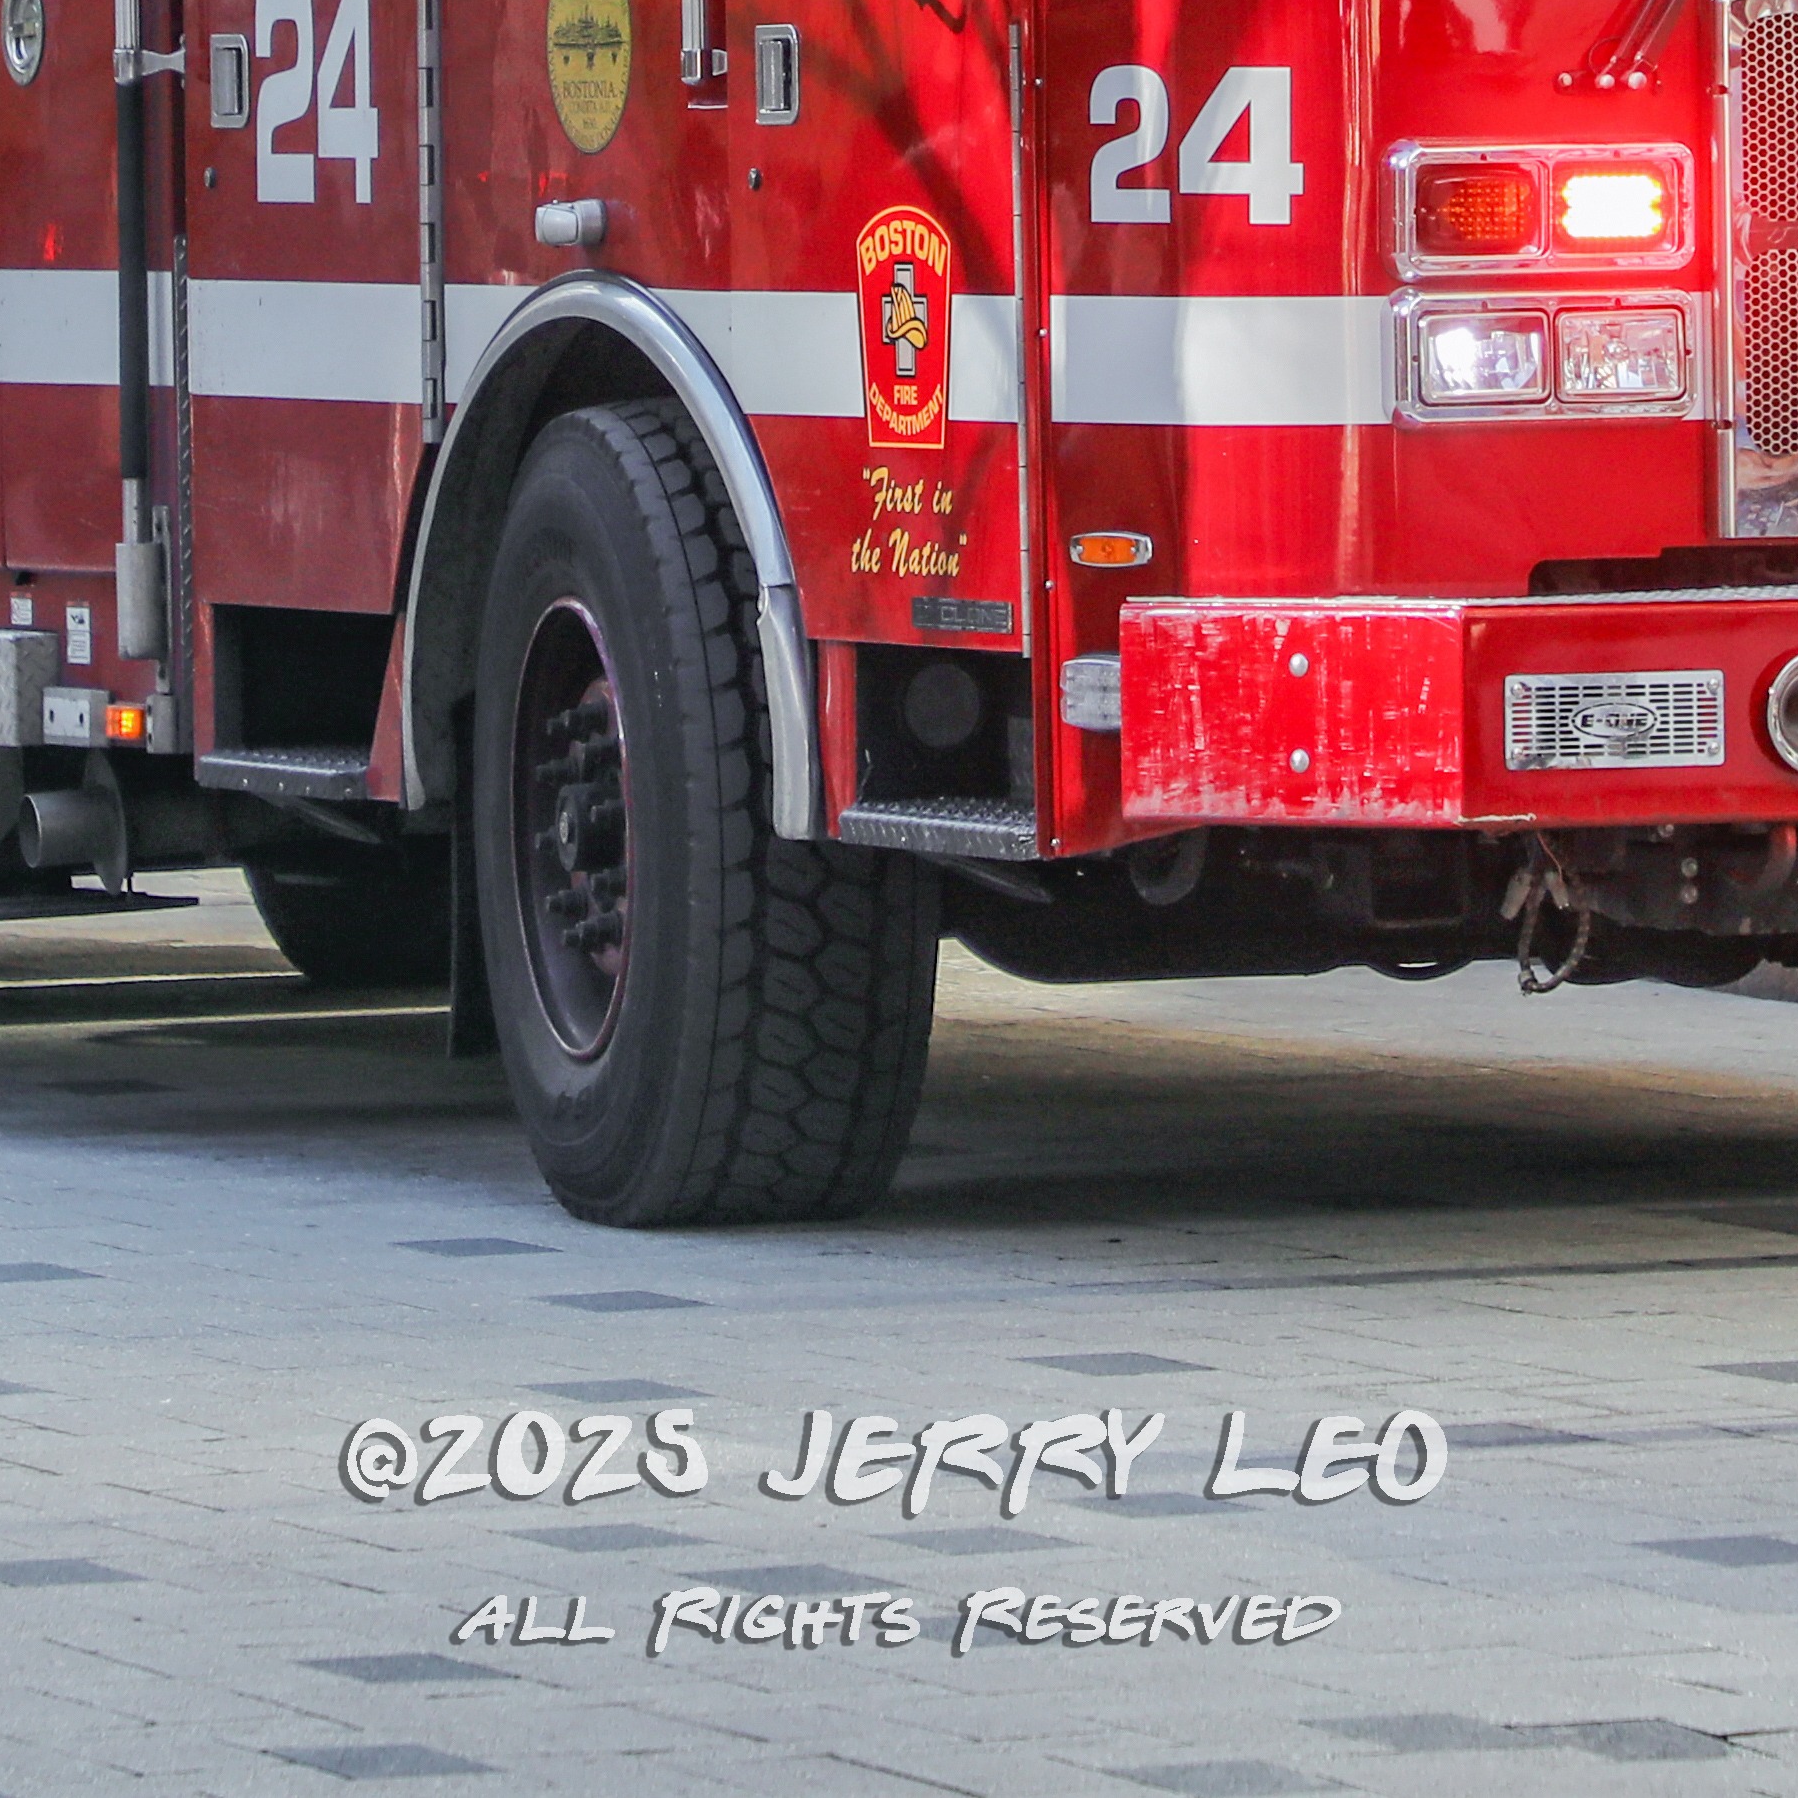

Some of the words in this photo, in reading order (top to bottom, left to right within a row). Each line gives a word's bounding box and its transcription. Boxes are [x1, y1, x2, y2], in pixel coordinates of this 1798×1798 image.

[1089, 65, 1305, 226] 24
[859, 219, 947, 277] BOSTON
[868, 381, 944, 436] DEPARTMENT
[893, 383, 919, 406] FIRE
[862, 465, 924, 521] "First
[932, 480, 954, 515] in
[851, 527, 882, 574] the
[888, 527, 968, 578] Nation"
[1579, 712, 1649, 729] E-ONE
